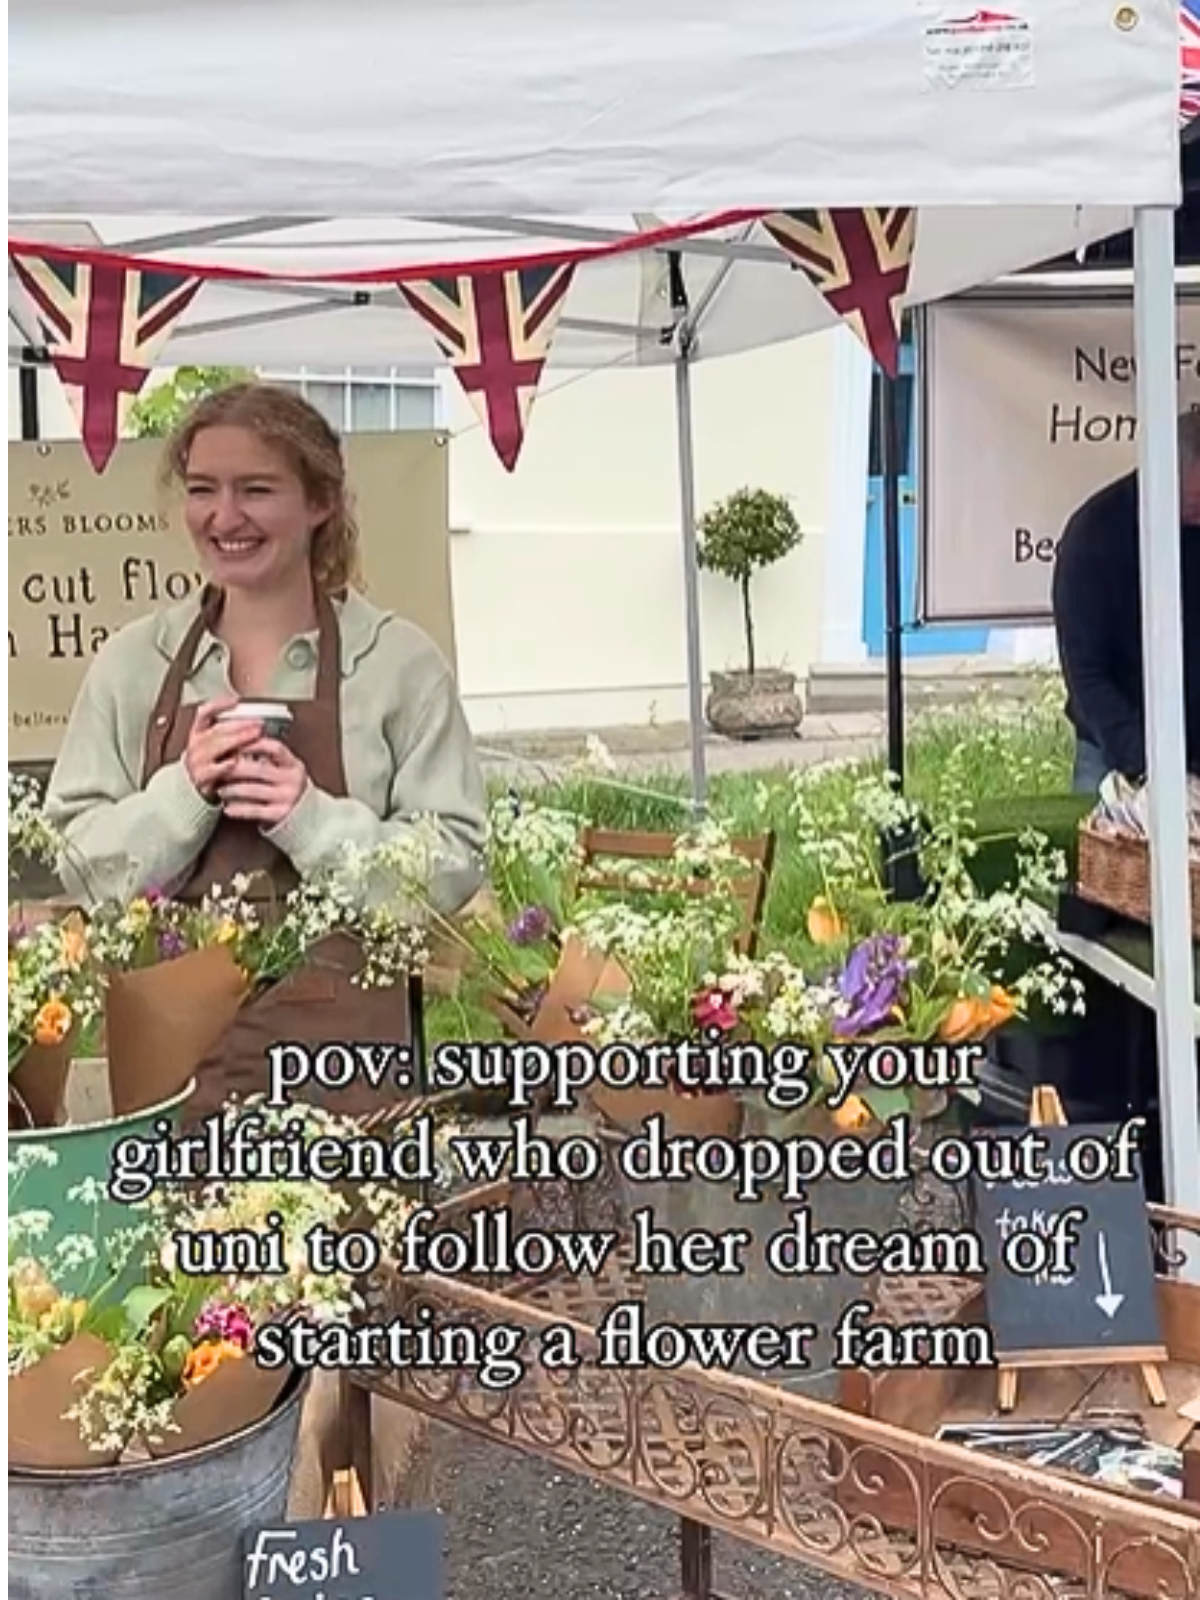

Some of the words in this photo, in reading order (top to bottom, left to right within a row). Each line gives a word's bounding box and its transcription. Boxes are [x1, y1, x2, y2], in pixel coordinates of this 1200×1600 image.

[1175, 343, 1200, 382] F
[62, 511, 171, 535] BLOOMS
[1015, 526, 1057, 564] Be
[22, 566, 98, 604] cut
[122, 555, 202, 601] flo
[47, 612, 120, 659] Ha
[246, 1526, 360, 1590] Fresh
